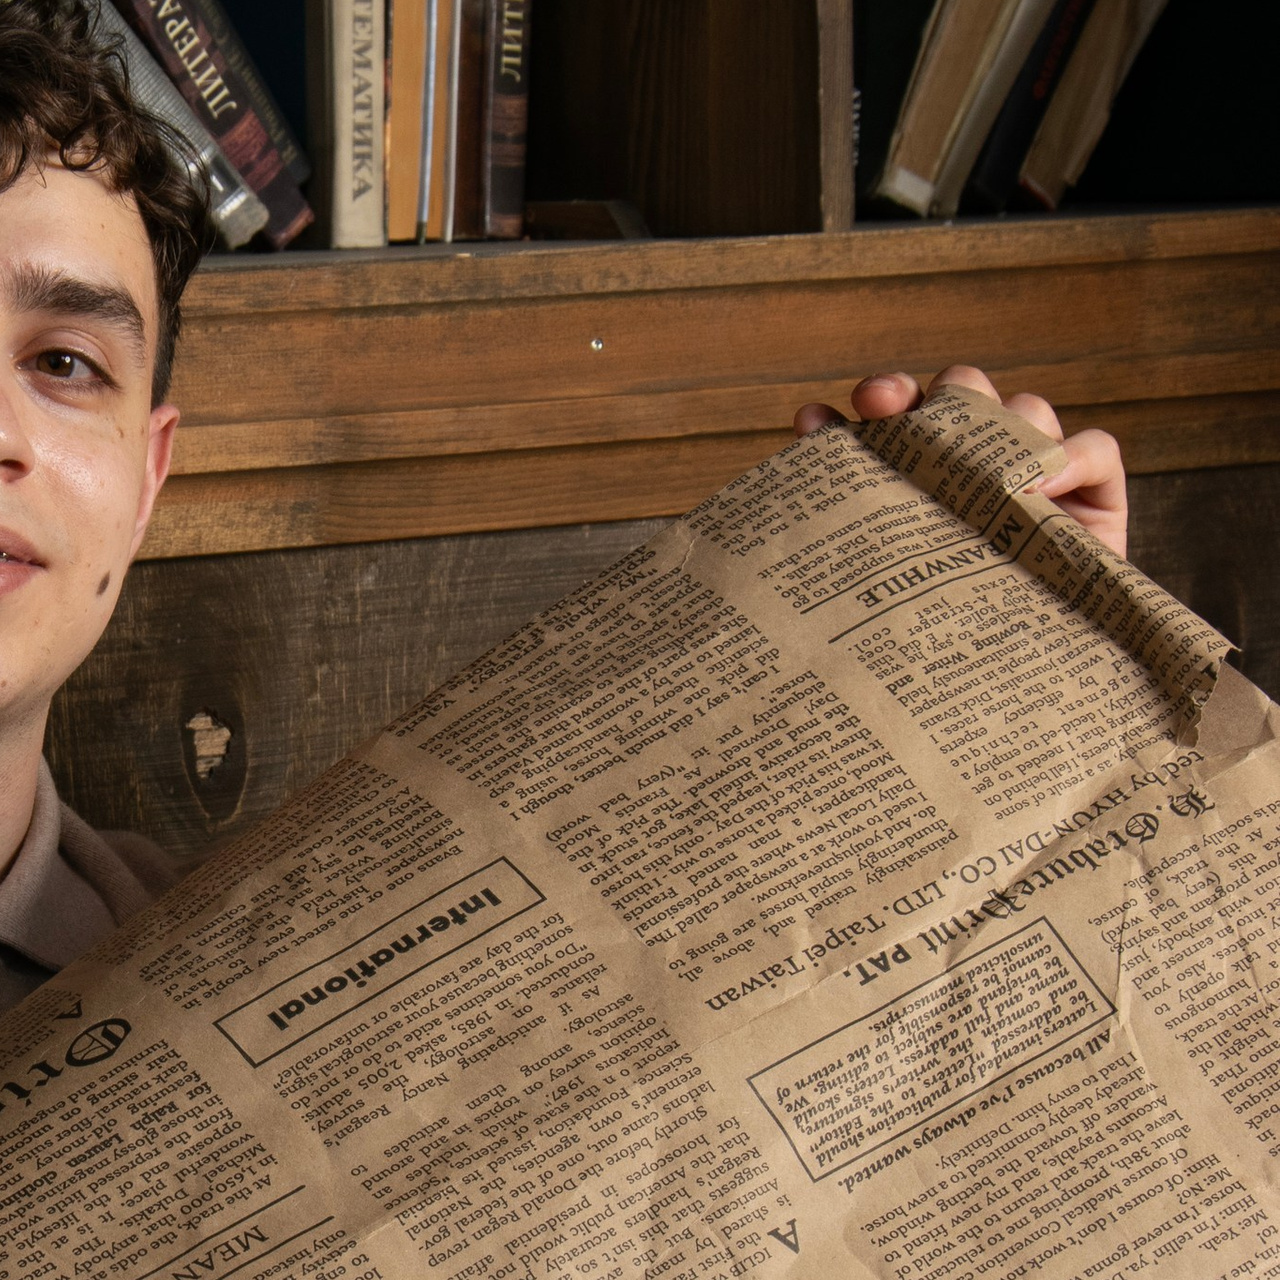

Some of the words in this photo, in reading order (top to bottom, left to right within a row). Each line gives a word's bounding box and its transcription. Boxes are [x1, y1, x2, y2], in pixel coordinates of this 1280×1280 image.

[856, 512, 1027, 608] MEANWHILE
[1129, 770, 1167, 792] by
[998, 784, 1130, 866] HYUN-DAI
[942, 856, 996, 883] CO.,
[883, 881, 946, 915] LTD.
[802, 914, 883, 967] Taipei
[962, 932, 1044, 983] unsolicited
[267, 887, 502, 1031] International
[515, 952, 595, 999] conducted.
[843, 943, 912, 986] PAT.
[1001, 944, 1051, 977] cannot
[1043, 955, 1063, 970] be
[704, 956, 806, 1010] Taiwan
[977, 967, 1041, 1010] briefand
[981, 973, 1001, 987] be
[1027, 966, 1069, 995] name
[1047, 978, 1077, 1004] and
[494, 997, 514, 1010] in
[867, 975, 965, 1032] manuscripts.
[898, 983, 979, 1035] responsible
[947, 1003, 972, 1023] are
[994, 992, 1023, 1017] and
[1068, 990, 1089, 1005] be
[450, 1009, 492, 1034] 1985,
[963, 1006, 991, 1034] full
[980, 1000, 1040, 1038] comtain
[990, 1004, 1061, 1052] addressed
[1042, 998, 1098, 1037] Latters
[403, 1033, 447, 1063] asked
[846, 1044, 871, 1062] the
[875, 1026, 895, 1048] for
[893, 1021, 943, 1055] subject
[899, 1028, 959, 1065] address.
[942, 1037, 974, 1057] the
[1084, 1024, 1110, 1055] All
[874, 1050, 889, 1064] to
[916, 1050, 985, 1088] "Letters
[976, 1032, 1042, 1077] intended
[1015, 1046, 1087, 1089] because
[357, 1058, 402, 1090] 2,005
[793, 1058, 843, 1090] return
[813, 1061, 869, 1094] editing.
[845, 1064, 895, 1096] Letters
[881, 1050, 941, 1094] writer's
[954, 1064, 976, 1088] for
[300, 1087, 352, 1122] adults:
[776, 1087, 790, 1105] of
[784, 1095, 810, 1113] We
[865, 1078, 952, 1136] publication
[869, 1099, 894, 1117] the
[900, 1086, 916, 1100] to
[978, 1084, 1016, 1110] I've
[792, 1093, 840, 1129] skould
[800, 1092, 874, 1135] signature,
[912, 1106, 976, 1149] always
[809, 1115, 863, 1153] Editor"
[815, 1131, 865, 1167] should
[837, 1145, 912, 1193] wanted.
[767, 1218, 799, 1254] A
